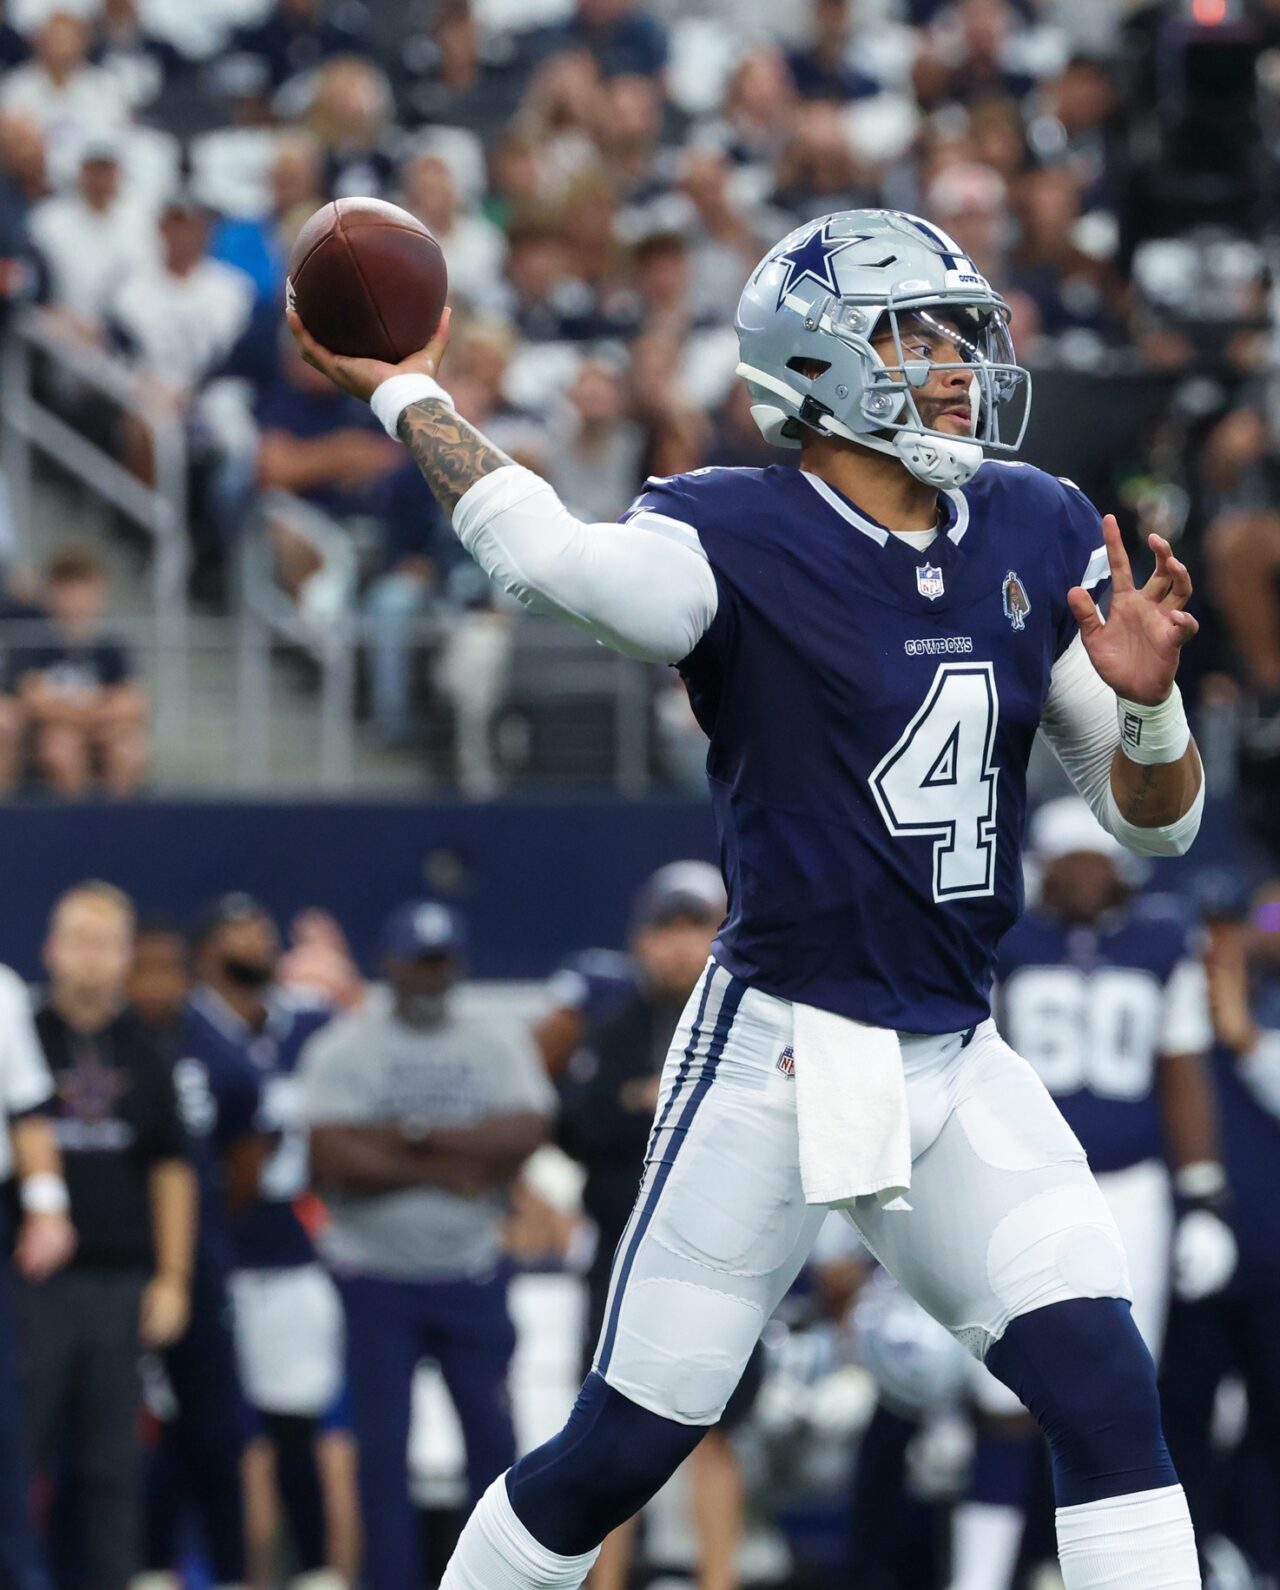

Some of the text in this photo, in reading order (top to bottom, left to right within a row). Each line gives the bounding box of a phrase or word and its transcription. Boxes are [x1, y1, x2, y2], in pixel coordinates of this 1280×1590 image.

[922, 579, 941, 594] NFL
[904, 637, 973, 655] COWBOYS
[867, 661, 1000, 903] 4
[1004, 965, 1162, 1102] 60
